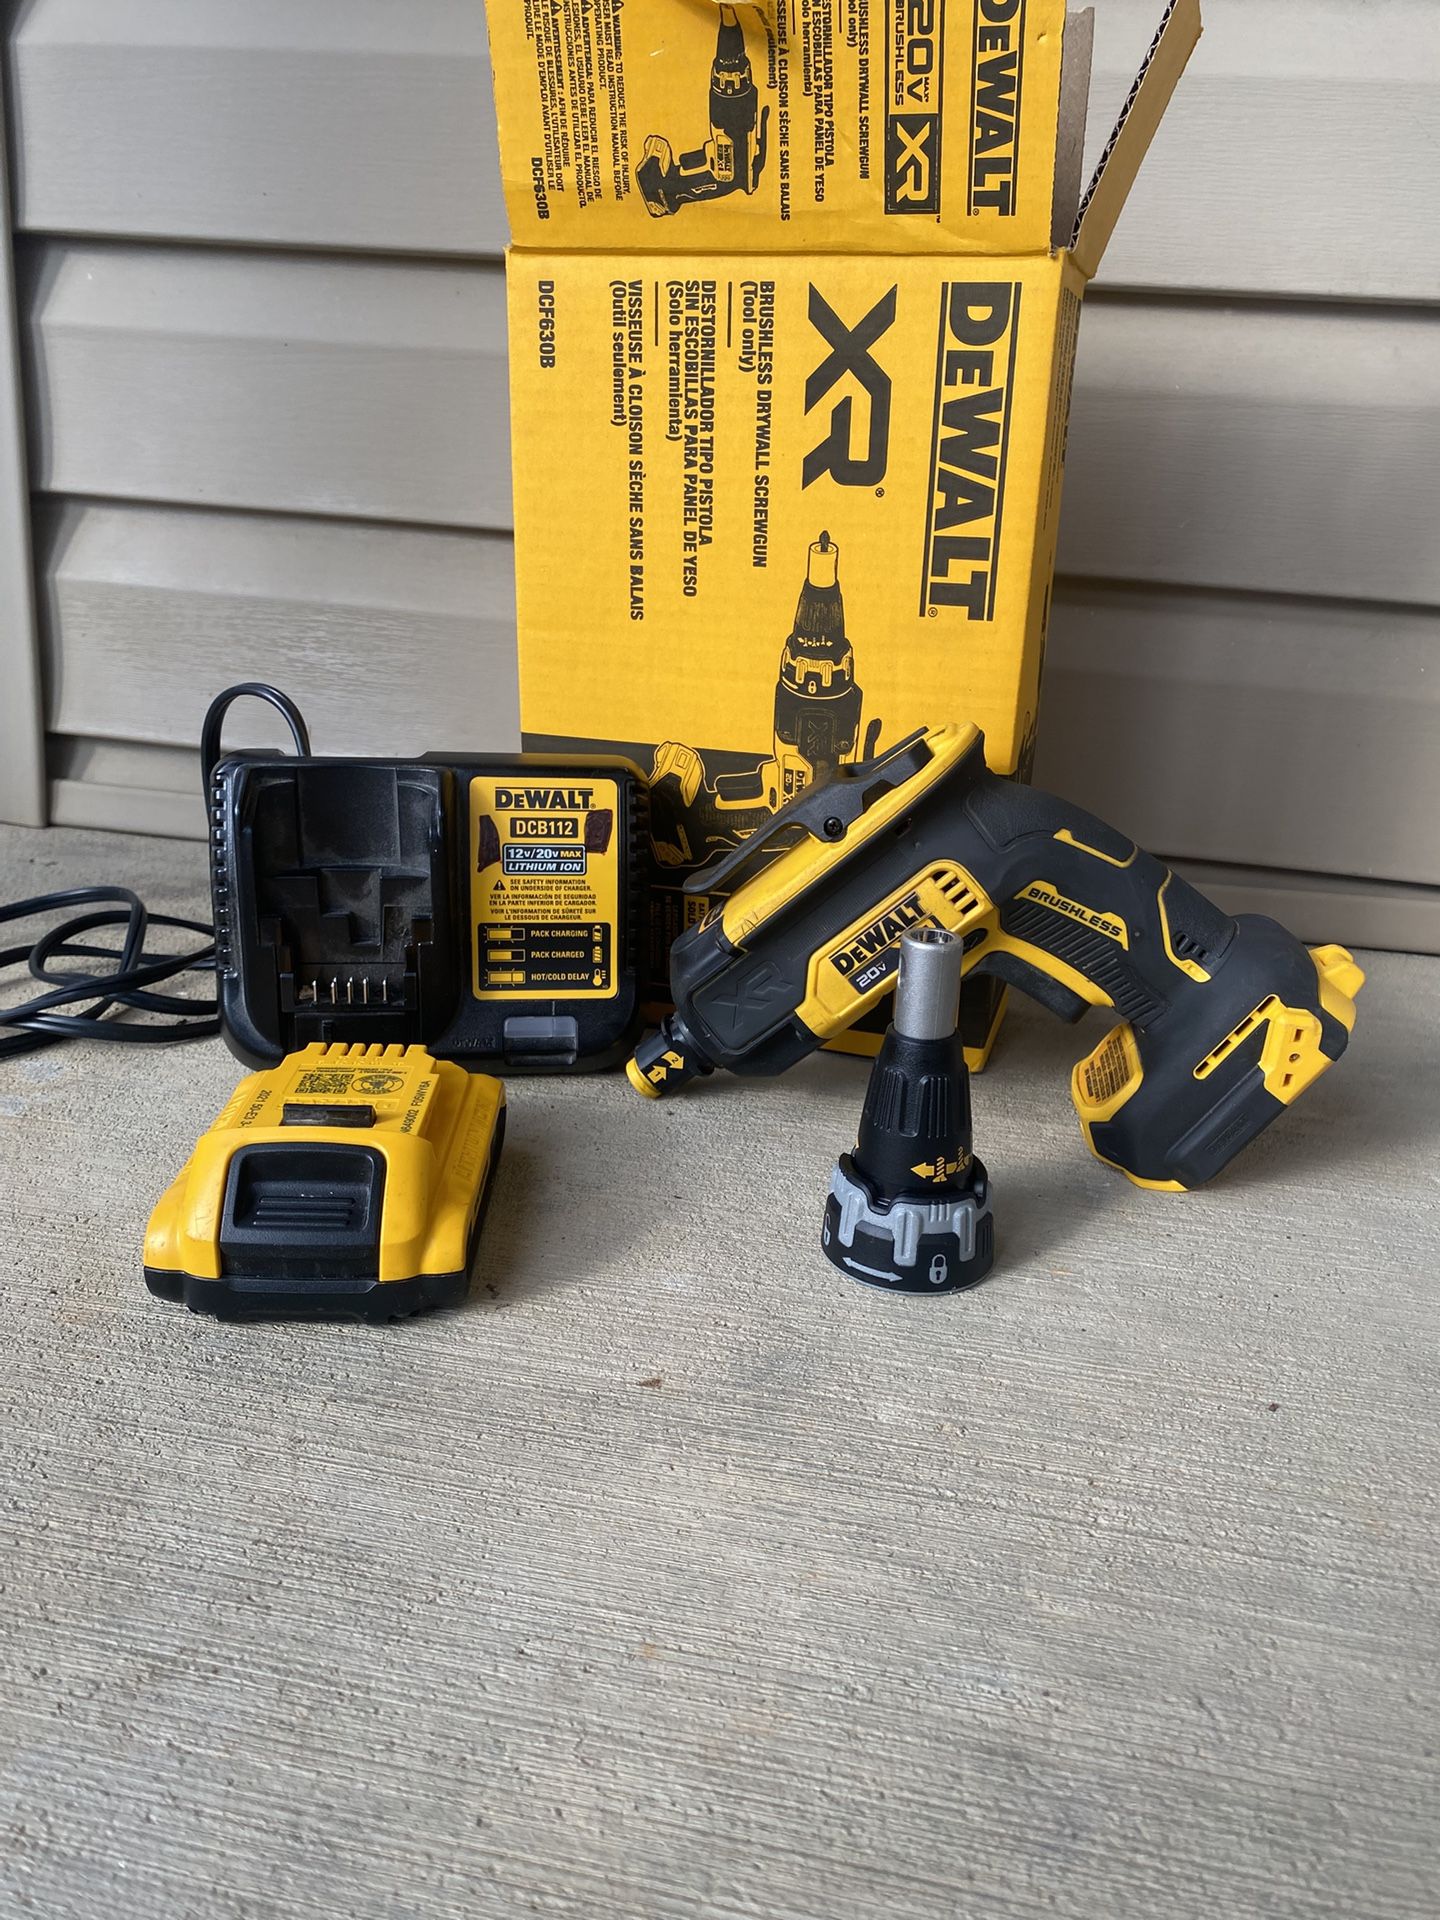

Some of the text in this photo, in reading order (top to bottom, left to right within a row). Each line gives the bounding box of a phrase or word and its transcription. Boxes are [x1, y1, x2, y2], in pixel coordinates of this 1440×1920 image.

[525, 0, 534, 40] PRODUIT.
[605, 22, 614, 47] MUST
[613, 14, 623, 60] WARNING:
[847, 18, 858, 47] only)
[575, 45, 583, 54] EL
[606, 49, 614, 72] READ
[615, 62, 623, 74] TO
[778, 48, 789, 56] À
[803, 22, 813, 96] herramienta)
[568, 70, 577, 97] ANTES
[576, 57, 586, 94] USUARIO
[597, 48, 606, 89] PRODUCT.
[779, 59, 788, 107] CLOISON
[533, 0, 555, 190] LIRE LE MODE D'EMPLOI AVANT D'UTILISER LE
[542, 0, 564, 192] LE RISQUE DE BLESSURES, L'UTILISATEUR DOIT
[558, 97, 567, 116] AFIN
[571, 100, 578, 110] DE
[579, 97, 587, 118] DEBE
[582, 17, 602, 199] ADVERTENCIA: PARA REDUCIR EL RIESGO DE
[608, 75, 618, 130] INSTRUCTION
[617, 76, 625, 109] REDUCE
[813, 11, 824, 202] ESCOBILLAS PARA PANEL DE YESO
[560, 119, 568, 129] DE
[572, 113, 581, 149] UTILIZAR
[780, 111, 790, 147] SÈCHE
[824, 92, 834, 166] TIPO PISTOLA
[859, 59, 869, 179] DRYWALL SCREWGUN
[562, 132, 570, 167] RÉDUIRE
[575, 152, 582, 162] EL
[582, 143, 589, 153] EL
[612, 133, 620, 168] MANUAL
[621, 152, 628, 162] OF
[780, 150, 789, 179] SANS
[896, 122, 930, 203] XR
[531, 158, 550, 219] DCF630B
[576, 164, 586, 208] PRODUCTO.
[583, 156, 592, 189] MANUAL
[614, 170, 622, 200] BEFORE
[586, 192, 594, 202] DE
[781, 183, 790, 220] BALAIS
[539, 281, 555, 368] DCF630B
[739, 281, 758, 372] (Tool only)
[609, 281, 627, 426] (Outil seulement)
[666, 281, 683, 441] (Solo herramienta)
[802, 282, 897, 491] XR
[699, 280, 716, 545] DESTORNILLADOR TIPO PISTOLA
[753, 281, 775, 567] BRUSHLESS DRYWALL SCREWGUN
[629, 280, 646, 620] VISSEUSE À CLOISON SÈCHE SANS BALAIS
[683, 280, 699, 597] SIN ESCOBILLAS PARA PANEL DE YESO
[929, 282, 1013, 620] DEWALT
[495, 790, 593, 809] DEWALT
[516, 821, 573, 835] DCB112
[508, 863, 556, 871] LITHIUM
[1028, 888, 1122, 936] BRUSHLESS
[831, 895, 926, 976] DEWALT
